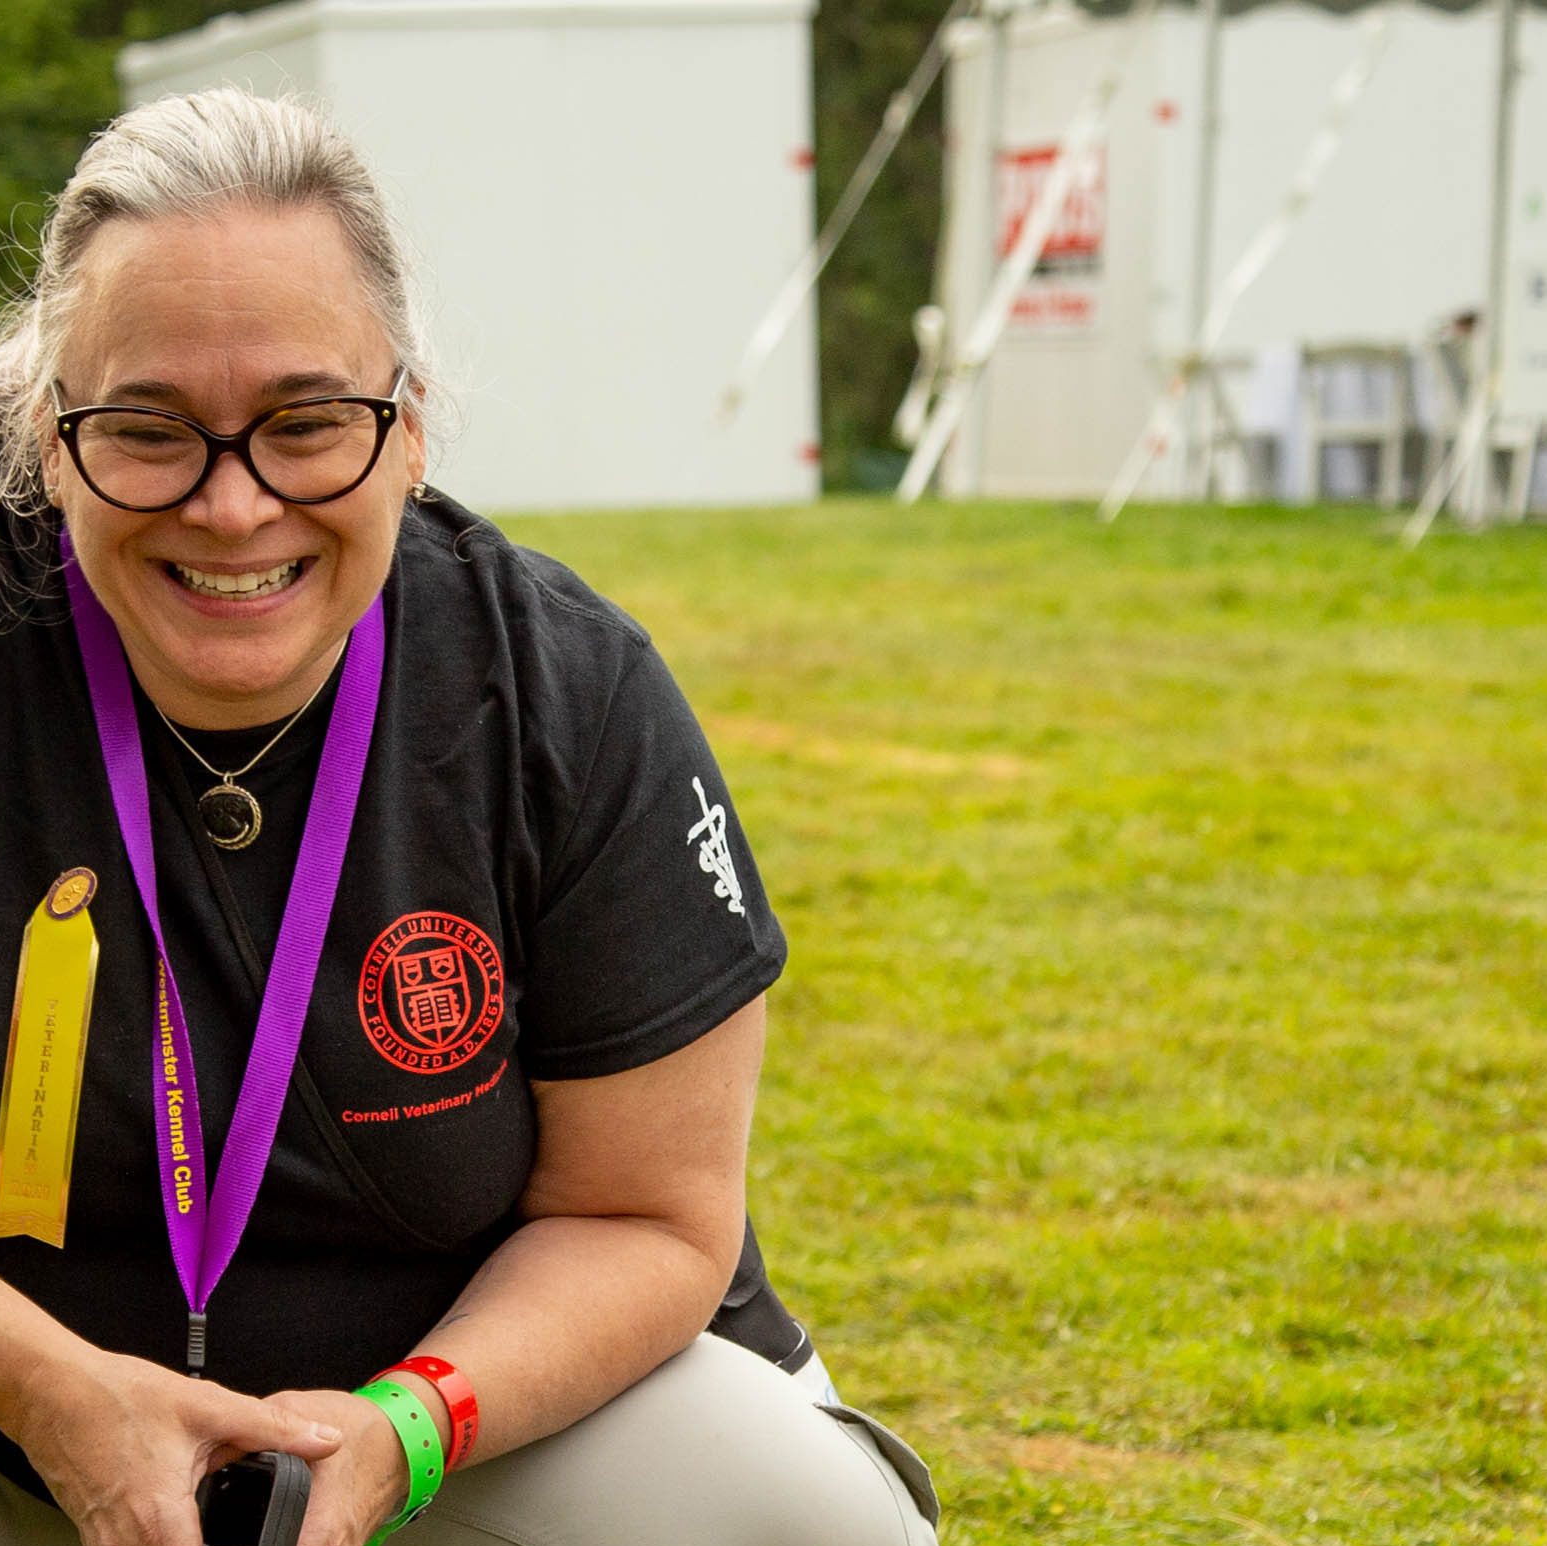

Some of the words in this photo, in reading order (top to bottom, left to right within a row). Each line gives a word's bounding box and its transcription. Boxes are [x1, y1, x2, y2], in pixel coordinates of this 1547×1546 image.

[364, 928, 407, 1004] CORNELL
[407, 918, 500, 981] UNIVERSITY
[158, 957, 180, 1086] Westminster
[368, 1015, 443, 1068] FOUNDED
[449, 1041, 479, 1064] A.D.
[478, 993, 502, 1037] 1865
[165, 1089, 187, 1162] Kennel
[341, 1108, 399, 1123] Cornell
[402, 1090, 474, 1119] Veterinary
[173, 1166, 194, 1215] Club
